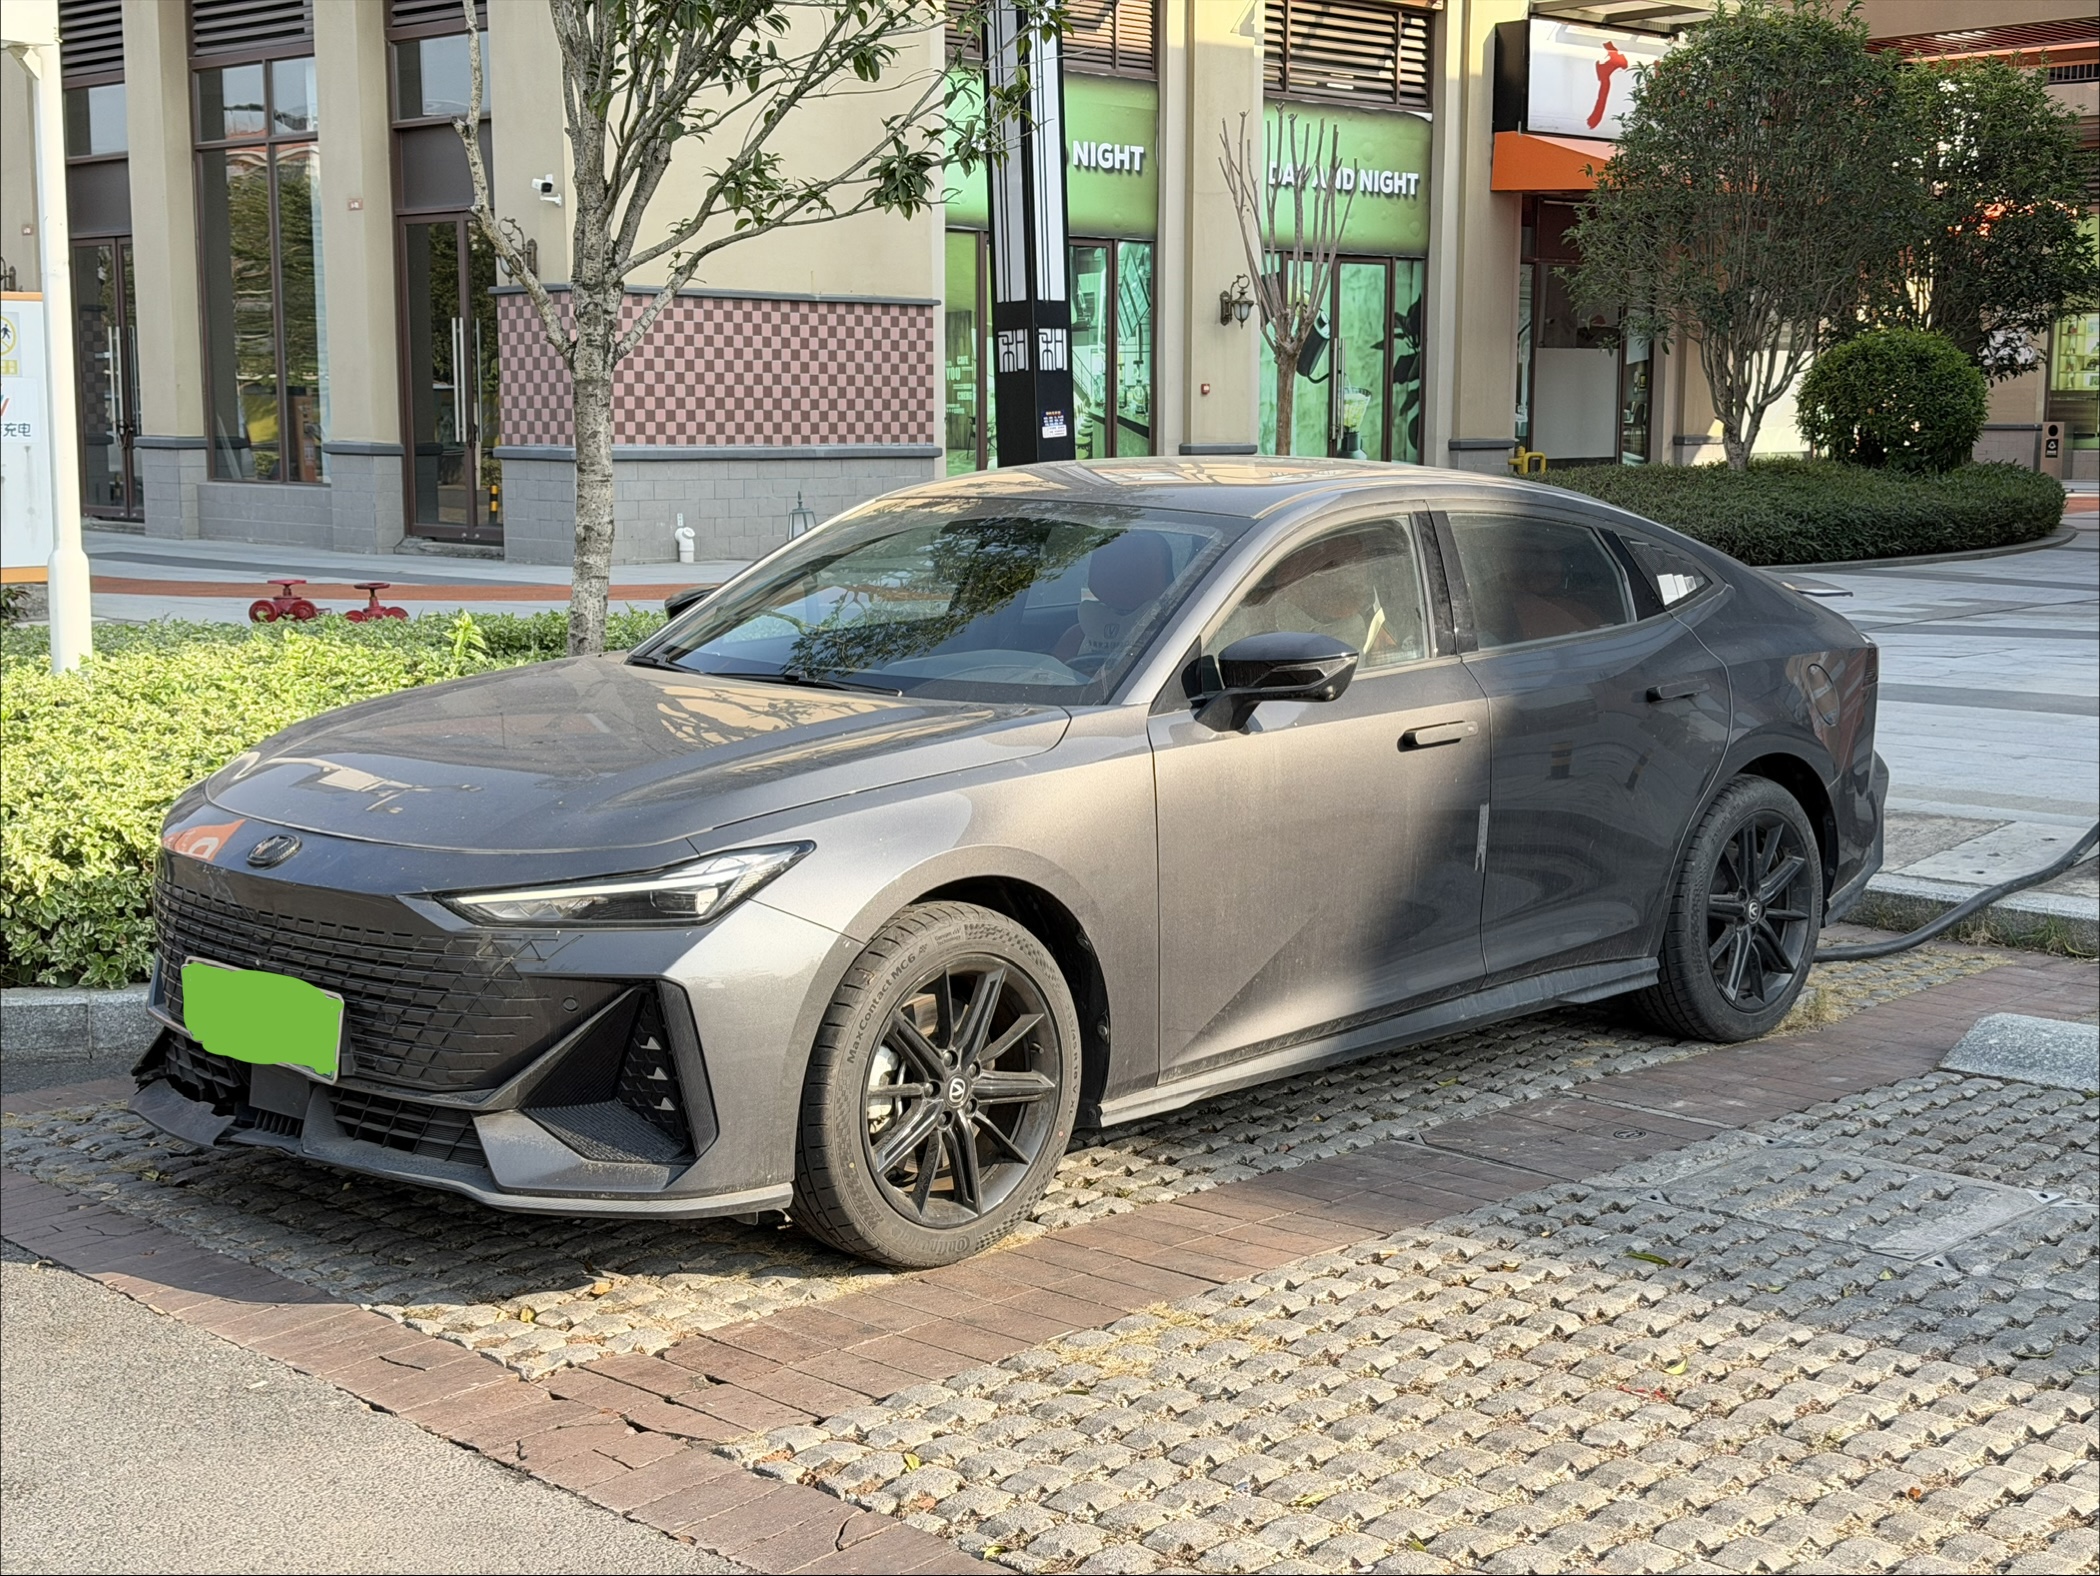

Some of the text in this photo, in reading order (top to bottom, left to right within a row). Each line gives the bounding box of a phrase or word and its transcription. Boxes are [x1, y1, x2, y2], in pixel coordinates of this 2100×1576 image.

[1072, 140, 1145, 172] NIGHT
[1359, 169, 1419, 196] NIGHT
[946, 366, 961, 381] YOU
[846, 953, 917, 1064] MaxContact MC6
